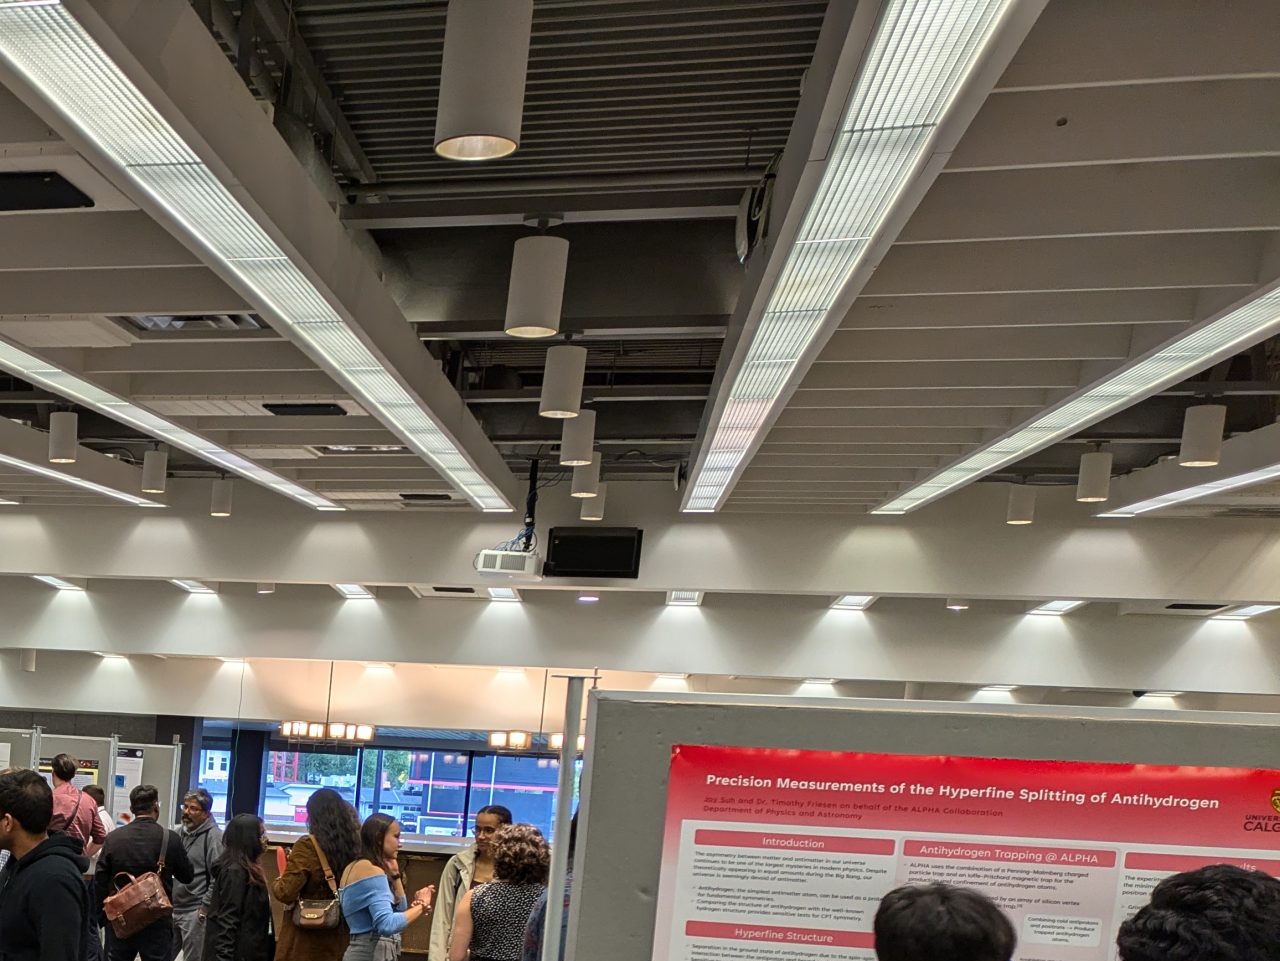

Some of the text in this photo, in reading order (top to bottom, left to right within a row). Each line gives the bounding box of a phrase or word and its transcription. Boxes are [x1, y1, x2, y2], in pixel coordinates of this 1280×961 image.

[706, 774, 1220, 812] Precision Measurements of the Hyperfine Splitting of Antihydrogen
[704, 804, 751, 815] Department
[765, 807, 795, 817] Physics
[817, 810, 862, 821] Astronomy
[762, 836, 824, 849] Introduction
[706, 851, 735, 859] asymmetry
[920, 844, 1098, 864] Antihydrogen Trapping @ ALPHA
[785, 862, 811, 870] mysteries
[697, 898, 726, 906] Comparing
[770, 902, 806, 911] antihydrogen
[735, 926, 833, 943] Hyperfine Structure
